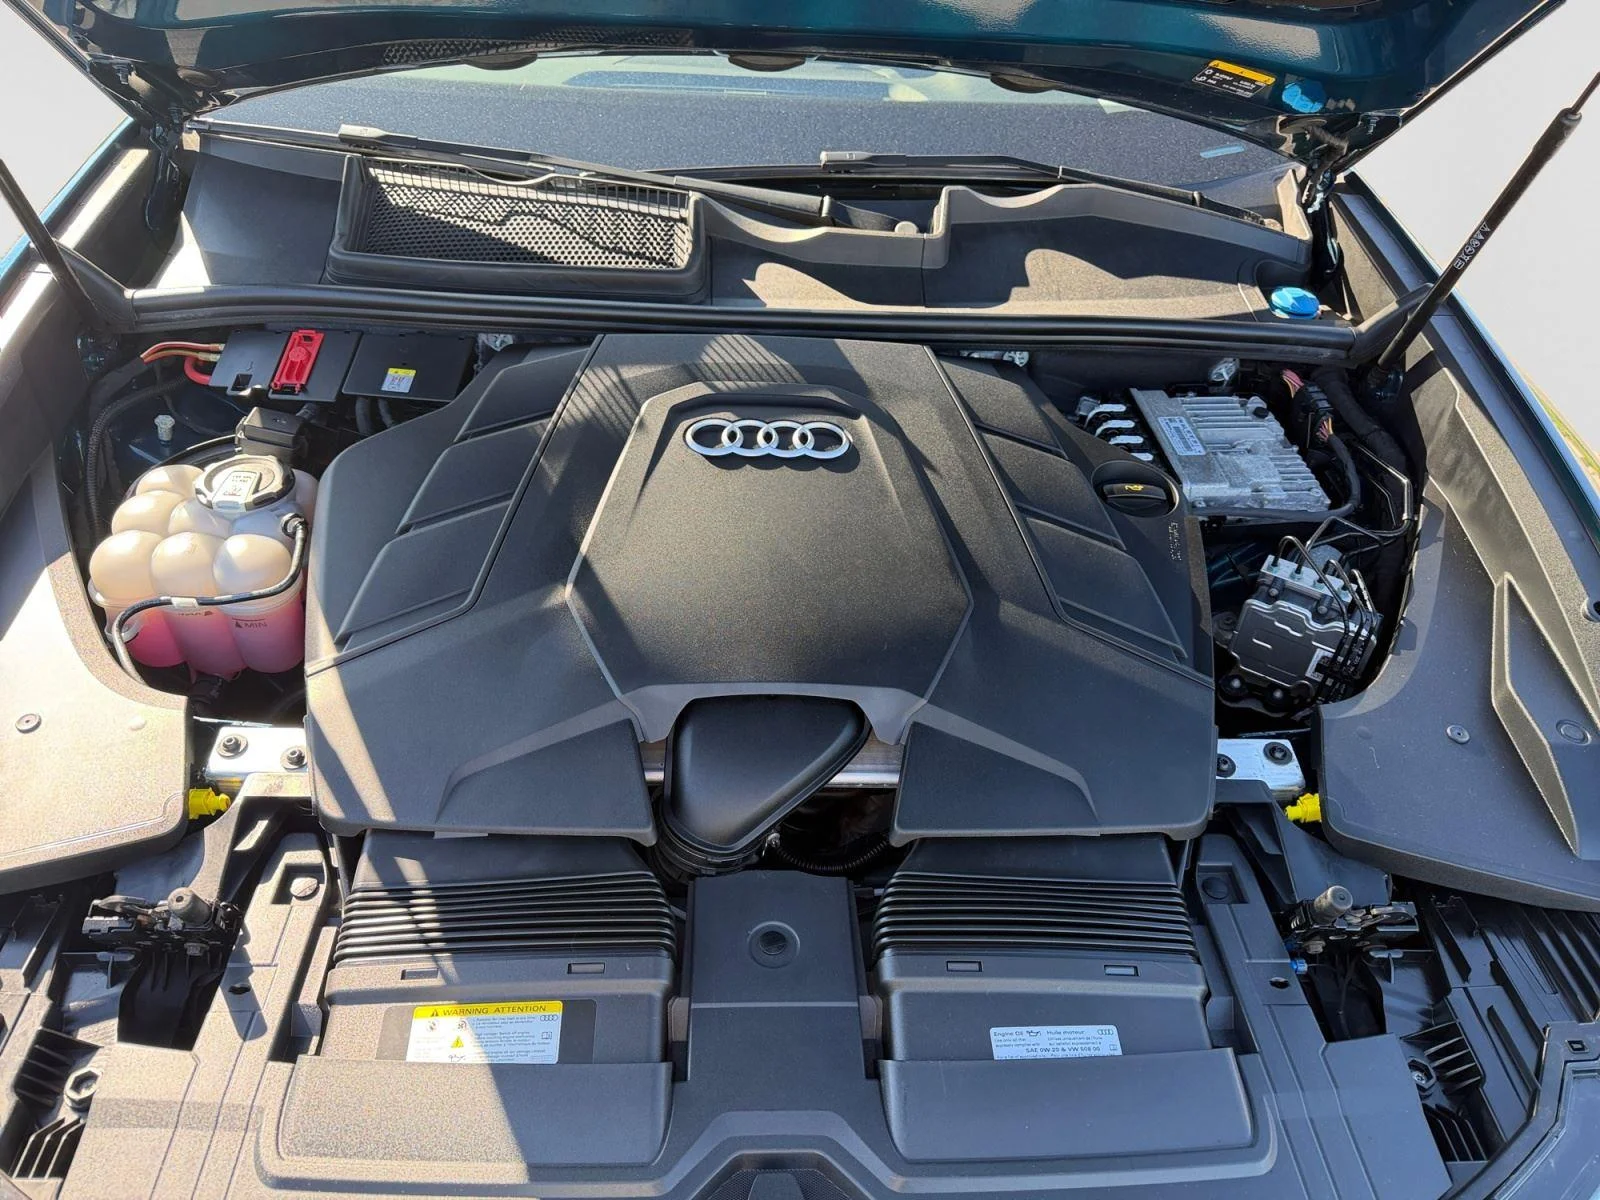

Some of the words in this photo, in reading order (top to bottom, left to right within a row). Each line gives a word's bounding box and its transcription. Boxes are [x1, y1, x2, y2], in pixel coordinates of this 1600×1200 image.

[244, 622, 268, 630] MIN
[442, 1007, 489, 1016] WARNING
[494, 1004, 547, 1014] ATTENTION
